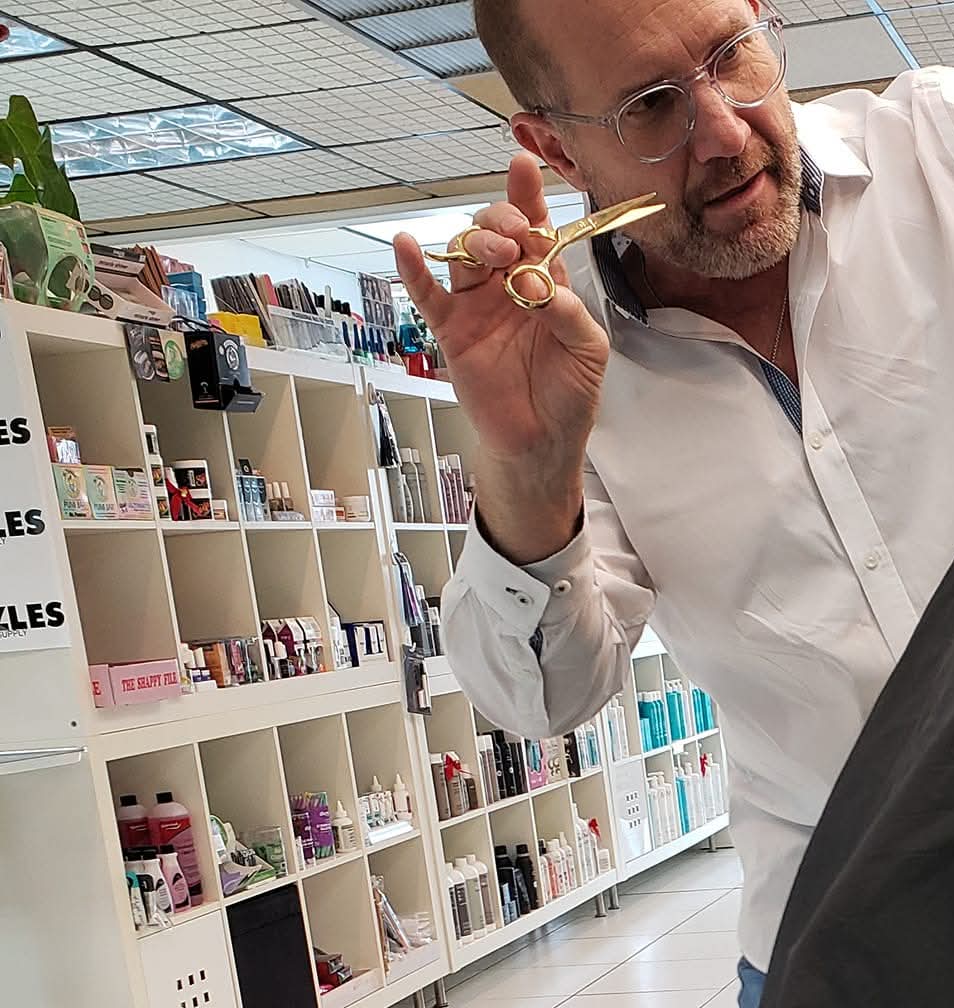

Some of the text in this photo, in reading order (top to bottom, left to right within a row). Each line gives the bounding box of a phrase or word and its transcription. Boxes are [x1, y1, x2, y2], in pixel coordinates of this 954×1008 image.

[0, 629, 27, 639] UPPLY
[121, 678, 136, 692] THE
[163, 671, 178, 686] FILE
